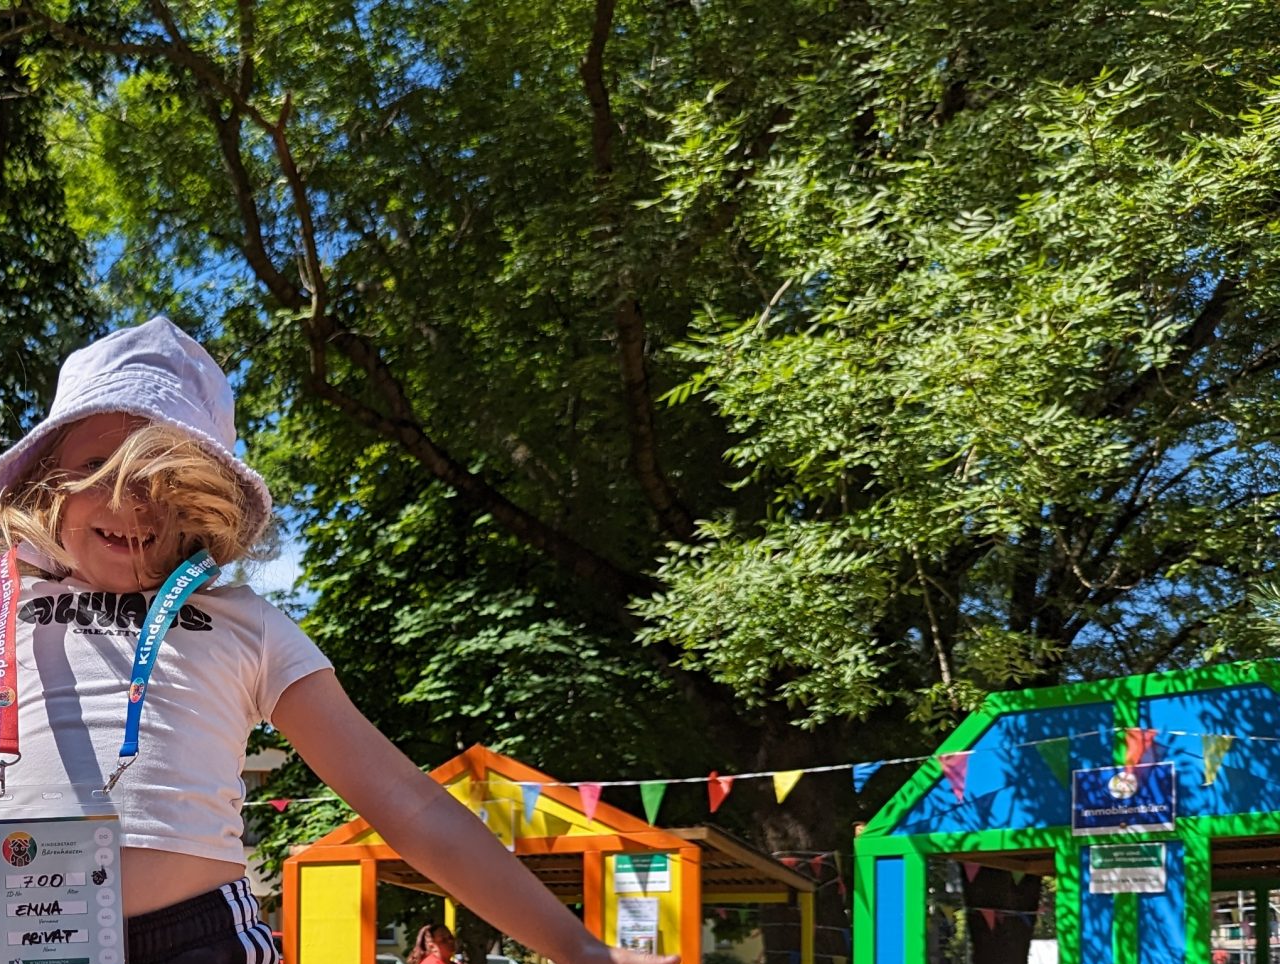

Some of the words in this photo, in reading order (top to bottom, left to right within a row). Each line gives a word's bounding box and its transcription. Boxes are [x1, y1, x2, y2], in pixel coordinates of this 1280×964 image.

[18, 592, 213, 632] ALWAS
[138, 575, 193, 665] Kinderstadt
[23, 873, 64, 888] 700
[15, 900, 63, 916] EMMA
